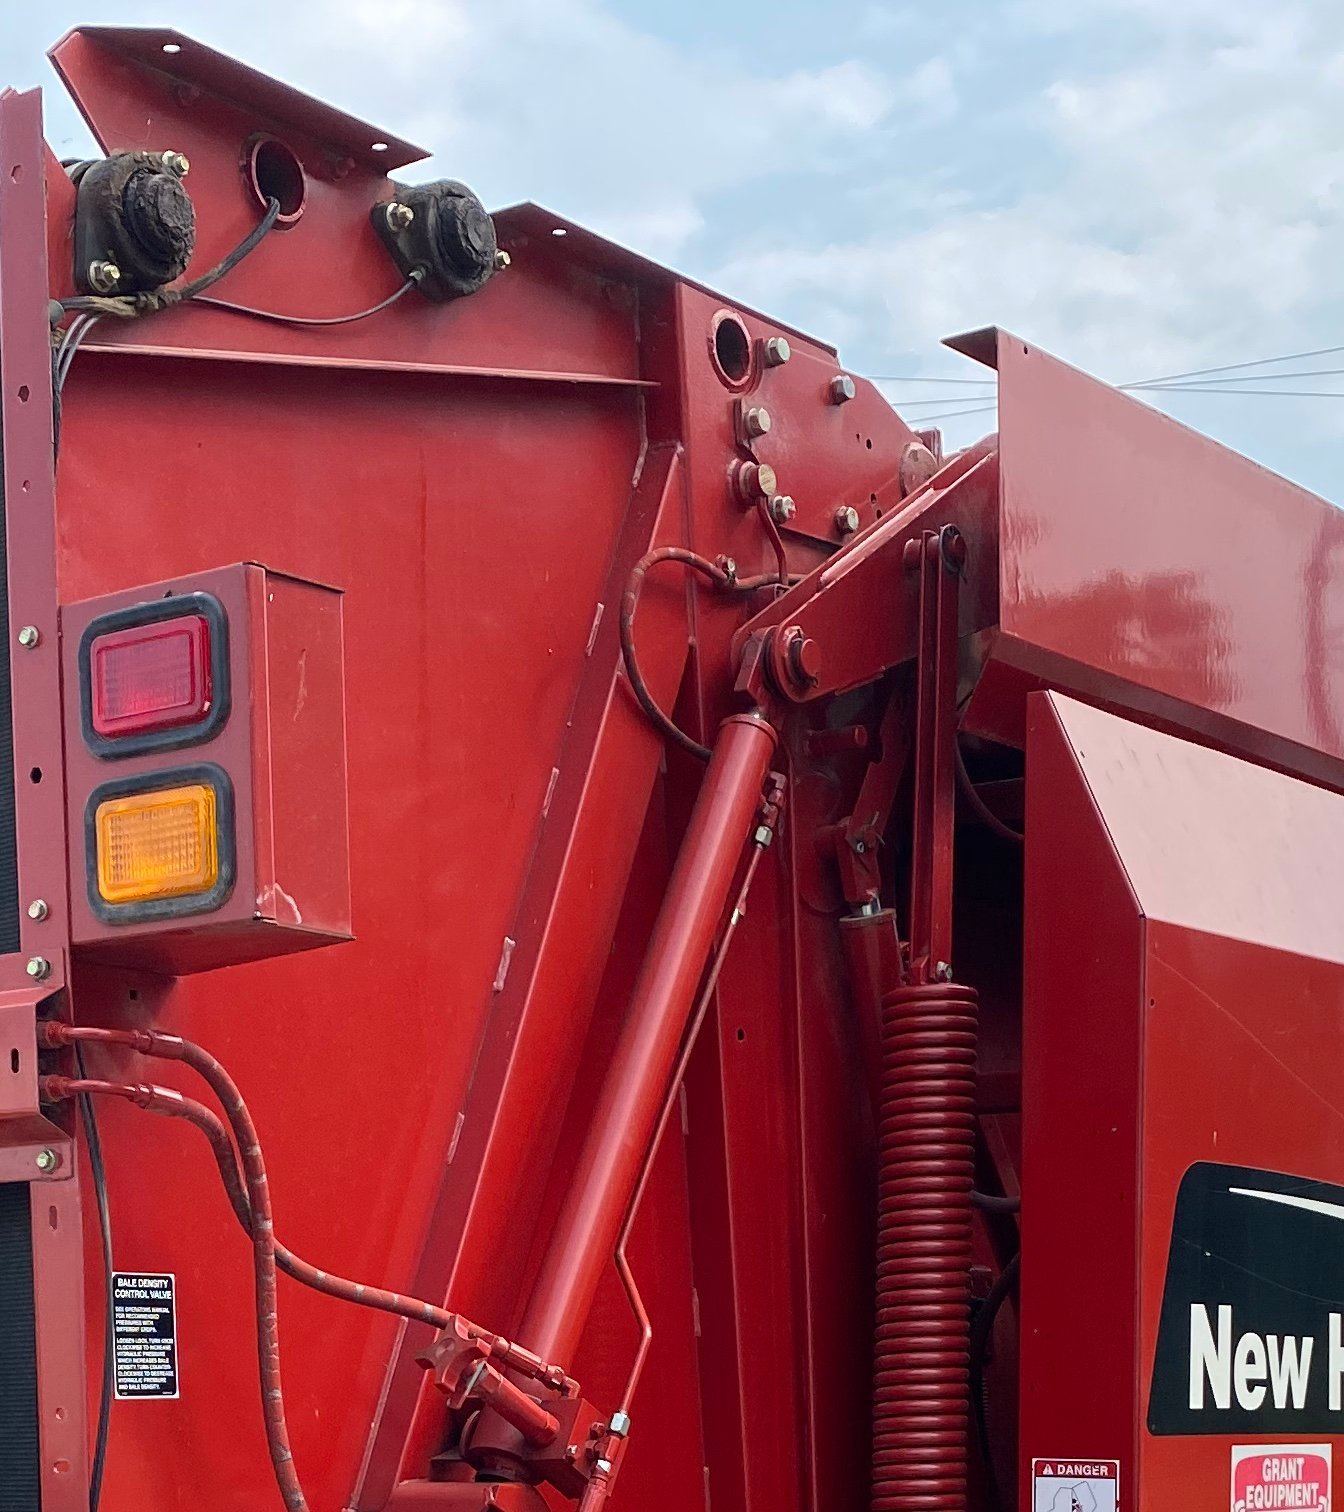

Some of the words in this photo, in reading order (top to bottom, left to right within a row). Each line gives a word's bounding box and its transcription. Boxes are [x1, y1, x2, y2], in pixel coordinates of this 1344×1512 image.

[118, 1278, 137, 1287] BALE
[138, 1279, 169, 1288] DENSITY
[115, 1289, 149, 1299] CONTROL
[150, 1291, 172, 1300] VALVE
[1189, 1303, 1314, 1411] New
[1057, 1464, 1109, 1476] DANGER
[1262, 1457, 1304, 1482] GRANT
[1245, 1483, 1319, 1509] EQUIPMENT
